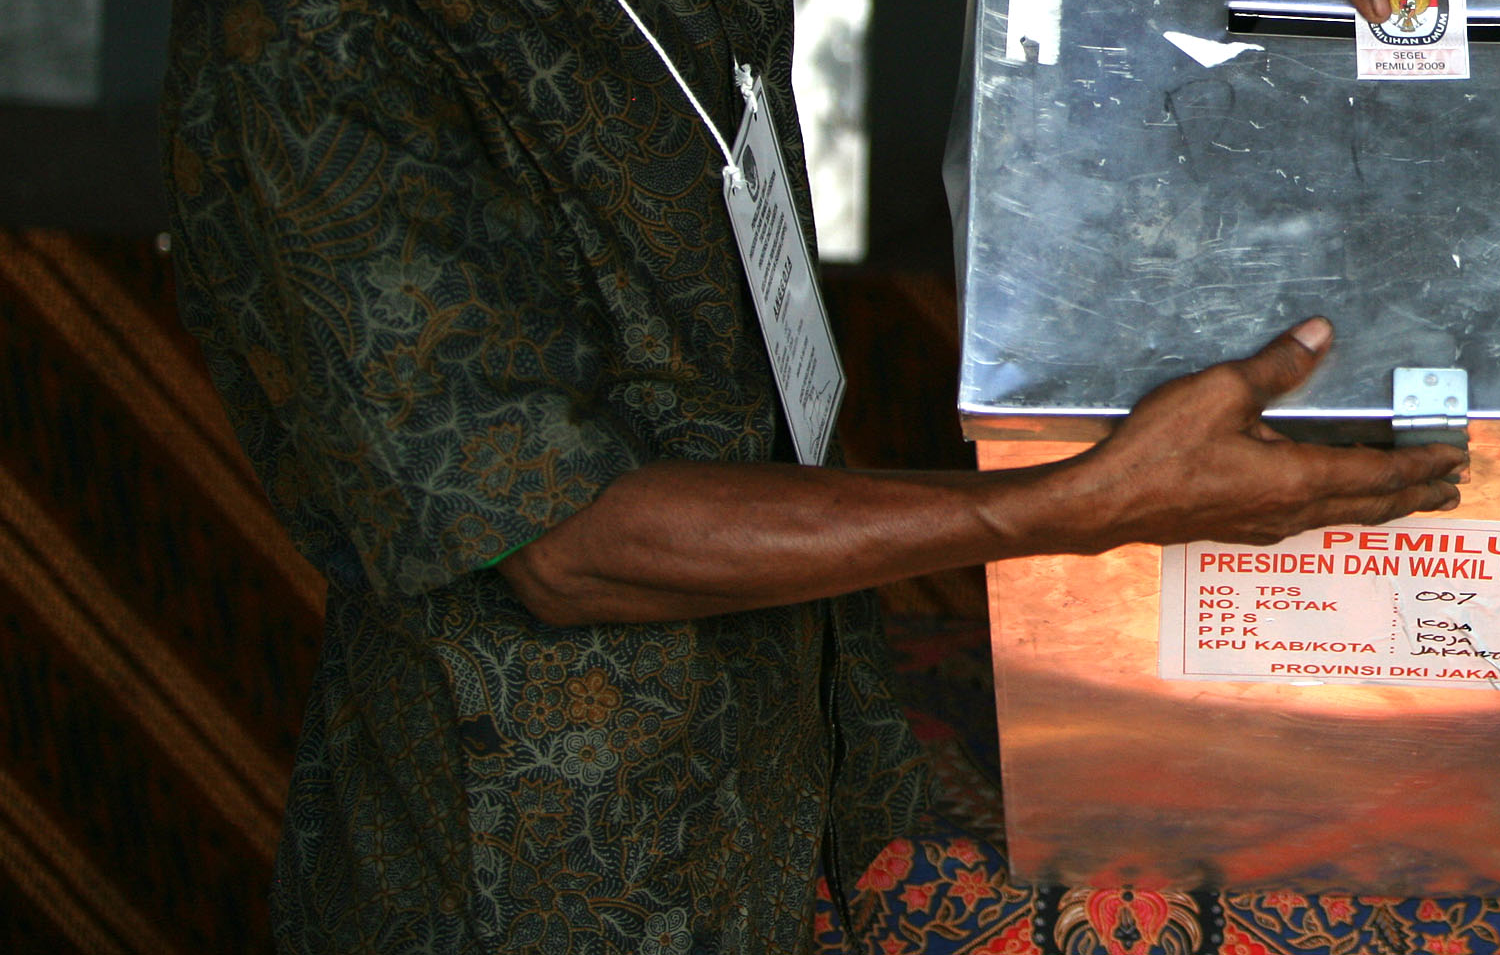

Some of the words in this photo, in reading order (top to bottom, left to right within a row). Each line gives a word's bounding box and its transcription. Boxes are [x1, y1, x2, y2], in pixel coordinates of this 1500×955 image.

[1370, 23, 1419, 45] EMILIHAN
[1422, 13, 1448, 44] UMUM
[1392, 51, 1427, 60] SEGEL
[1375, 62, 1414, 71] PEMILU
[1417, 62, 1446, 70] 2009
[1199, 552, 1335, 575] PRESIDEN
[1343, 554, 1400, 577] DAN
[1408, 556, 1494, 580] WAKIL
[1199, 585, 1240, 596] NO.
[1256, 586, 1302, 597] TPS
[1415, 590, 1478, 605] 007
[1199, 599, 1240, 610] NO.
[1255, 600, 1339, 612] KOTAK
[1198, 639, 1246, 650] KPU
[1255, 640, 1377, 654] KAB/KOTA
[1270, 663, 1382, 676] PROVINSI
[1389, 666, 1429, 678] DKI
